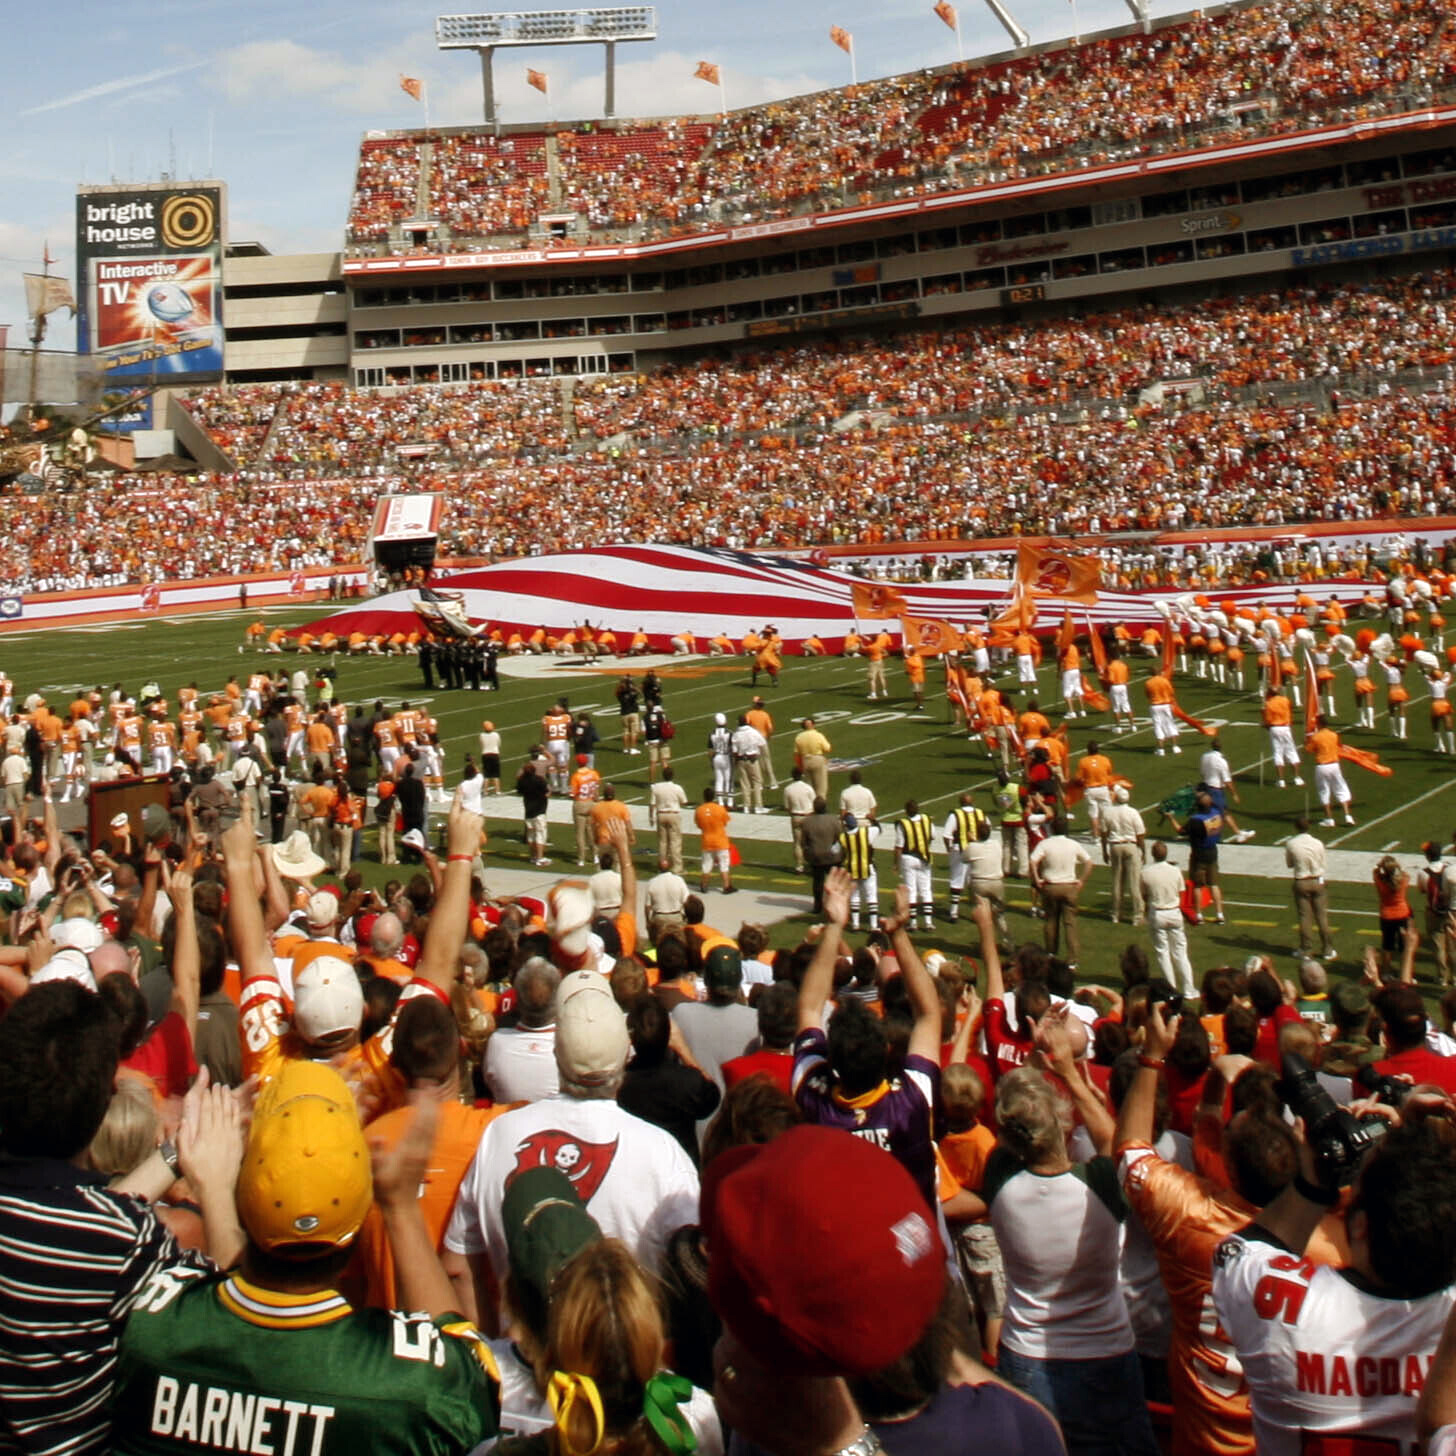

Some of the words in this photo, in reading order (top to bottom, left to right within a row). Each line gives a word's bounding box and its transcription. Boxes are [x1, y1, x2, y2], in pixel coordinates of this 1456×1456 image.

[87, 202, 154, 224] bright
[87, 225, 156, 243] house
[1181, 216, 1220, 235] Sprint
[100, 262, 177, 279] Interactive
[99, 281, 130, 306] TV
[151, 1375, 335, 1456] BARNETT
